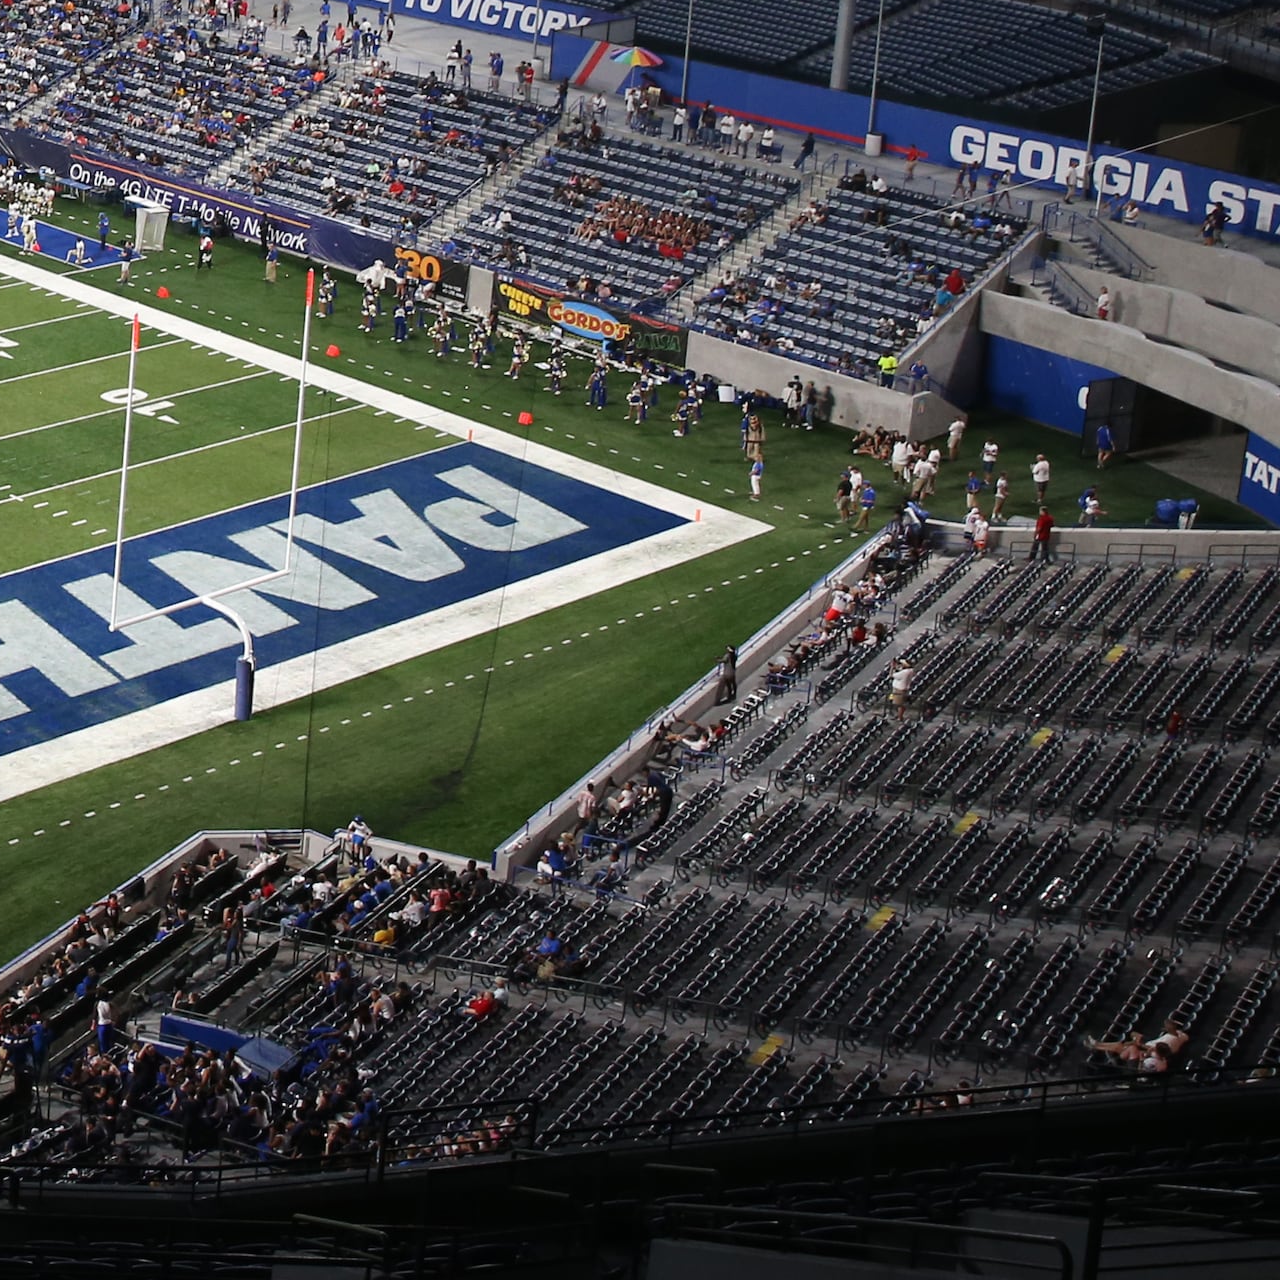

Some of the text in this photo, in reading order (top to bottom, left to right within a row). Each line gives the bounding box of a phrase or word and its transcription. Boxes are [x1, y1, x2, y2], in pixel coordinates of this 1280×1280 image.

[69, 163, 91, 184] On
[93, 170, 116, 187] the
[119, 178, 141, 198] 4G
[949, 124, 1189, 213] GEORGIA
[395, 245, 440, 283] $30
[499, 283, 543, 310] CHEESE
[508, 299, 531, 317] DIP
[548, 302, 630, 341] GORDO'S
[99, 387, 176, 417] 10
